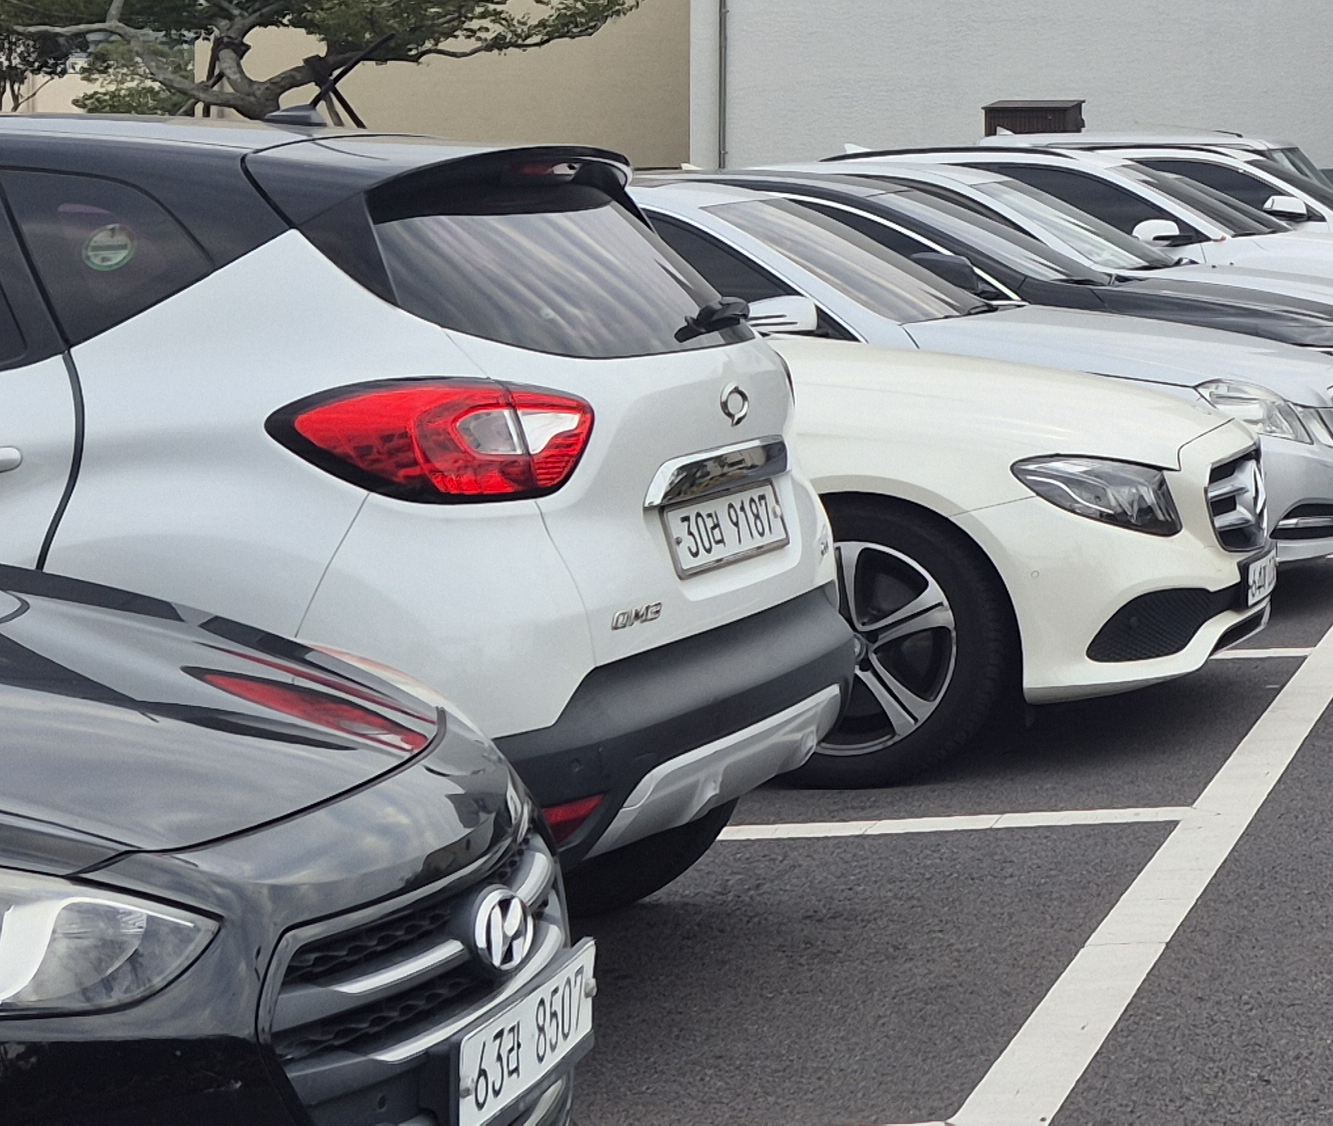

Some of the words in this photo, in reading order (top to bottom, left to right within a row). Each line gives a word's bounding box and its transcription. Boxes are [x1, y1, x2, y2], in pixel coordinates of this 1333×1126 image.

[727, 493, 773, 545] 9187
[474, 1020, 522, 1111] 63라
[536, 965, 584, 1064] 8507
